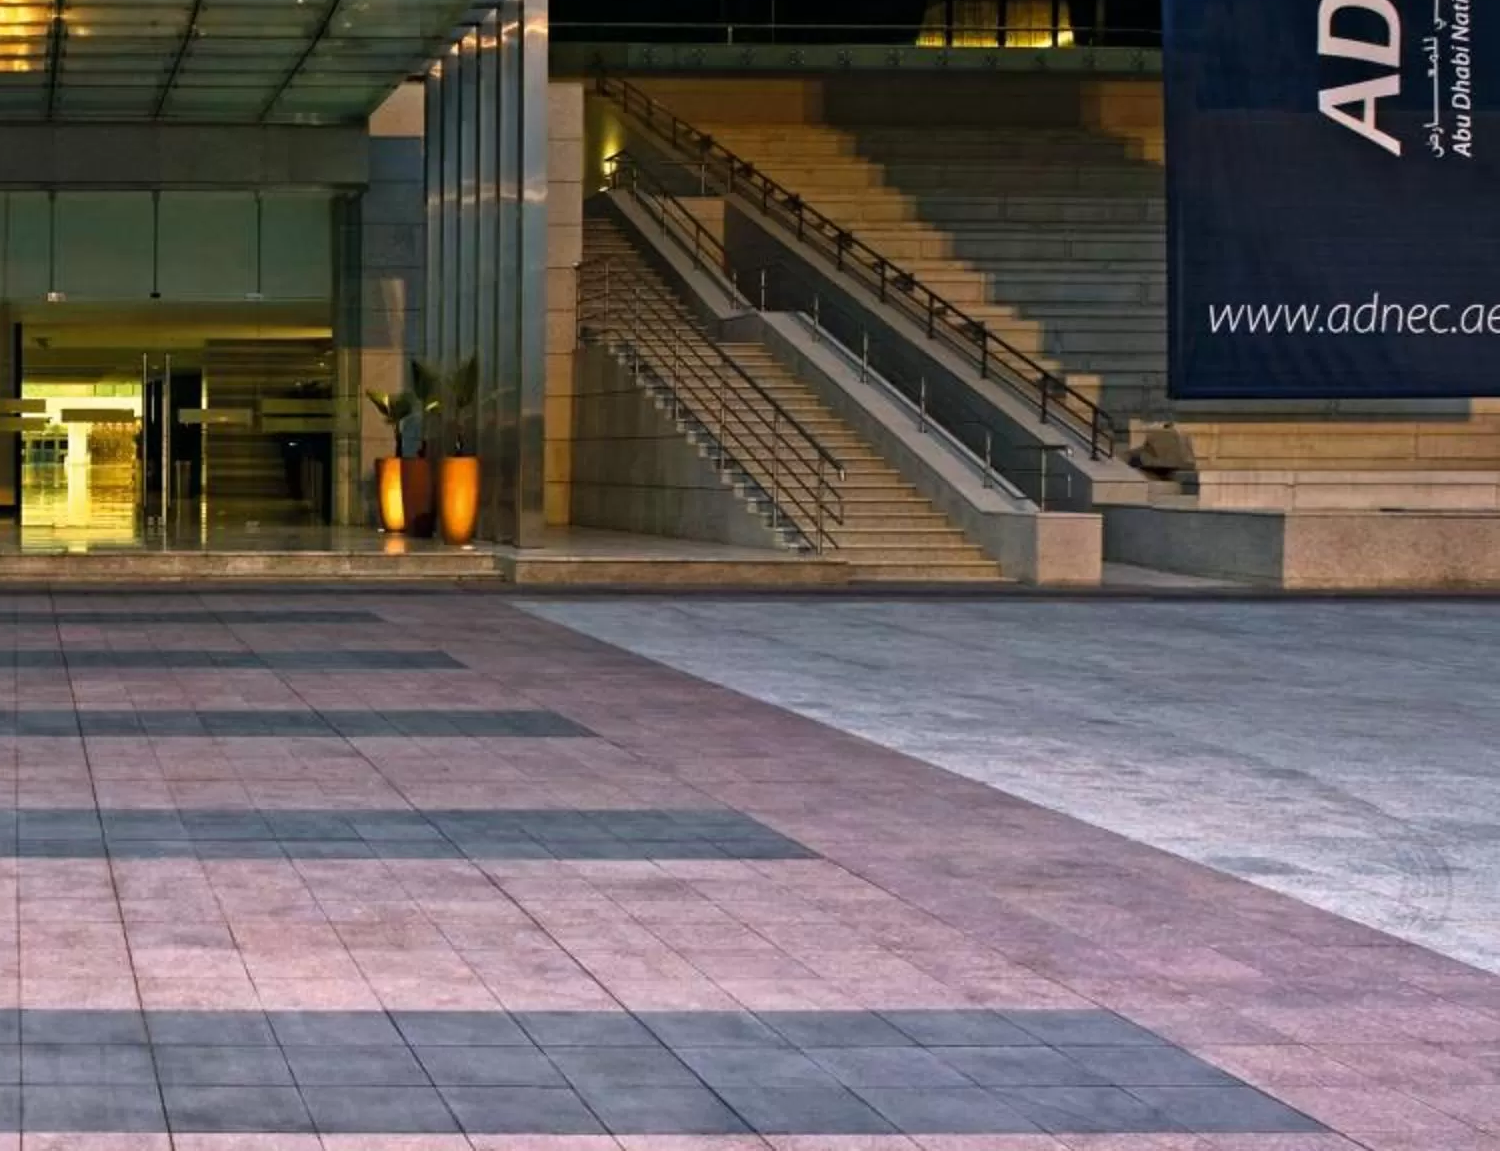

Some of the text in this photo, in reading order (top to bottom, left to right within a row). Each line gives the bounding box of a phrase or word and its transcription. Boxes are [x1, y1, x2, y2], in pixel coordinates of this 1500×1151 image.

[1451, 45, 1471, 110] Dhabi
[1453, 115, 1472, 158] Abu
[1208, 290, 1500, 334] www.adnec.ae
